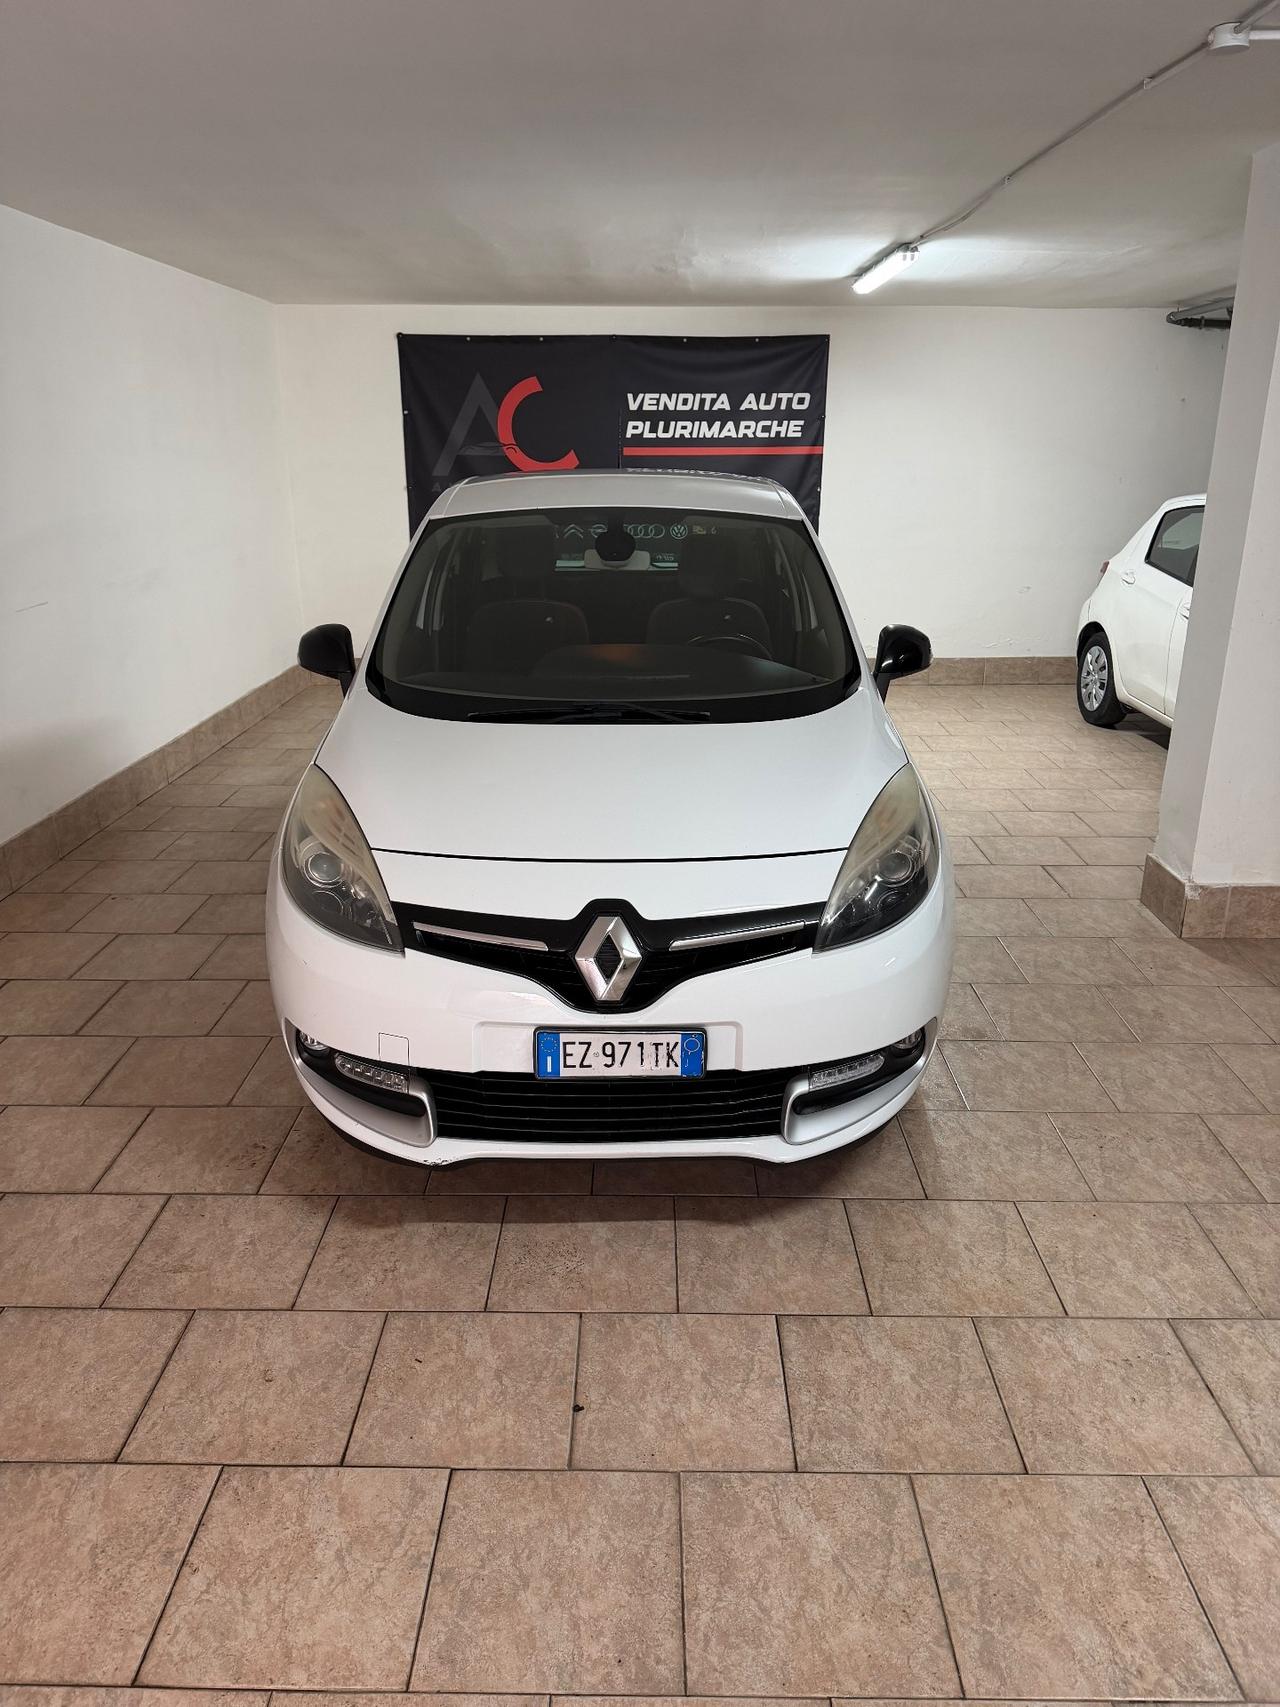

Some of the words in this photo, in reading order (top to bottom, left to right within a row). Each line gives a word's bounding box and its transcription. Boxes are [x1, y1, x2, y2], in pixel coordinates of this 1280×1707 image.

[627, 393, 731, 411] VENDITA
[740, 392, 811, 410] AUTO
[625, 420, 805, 438] PLURIMARCHE
